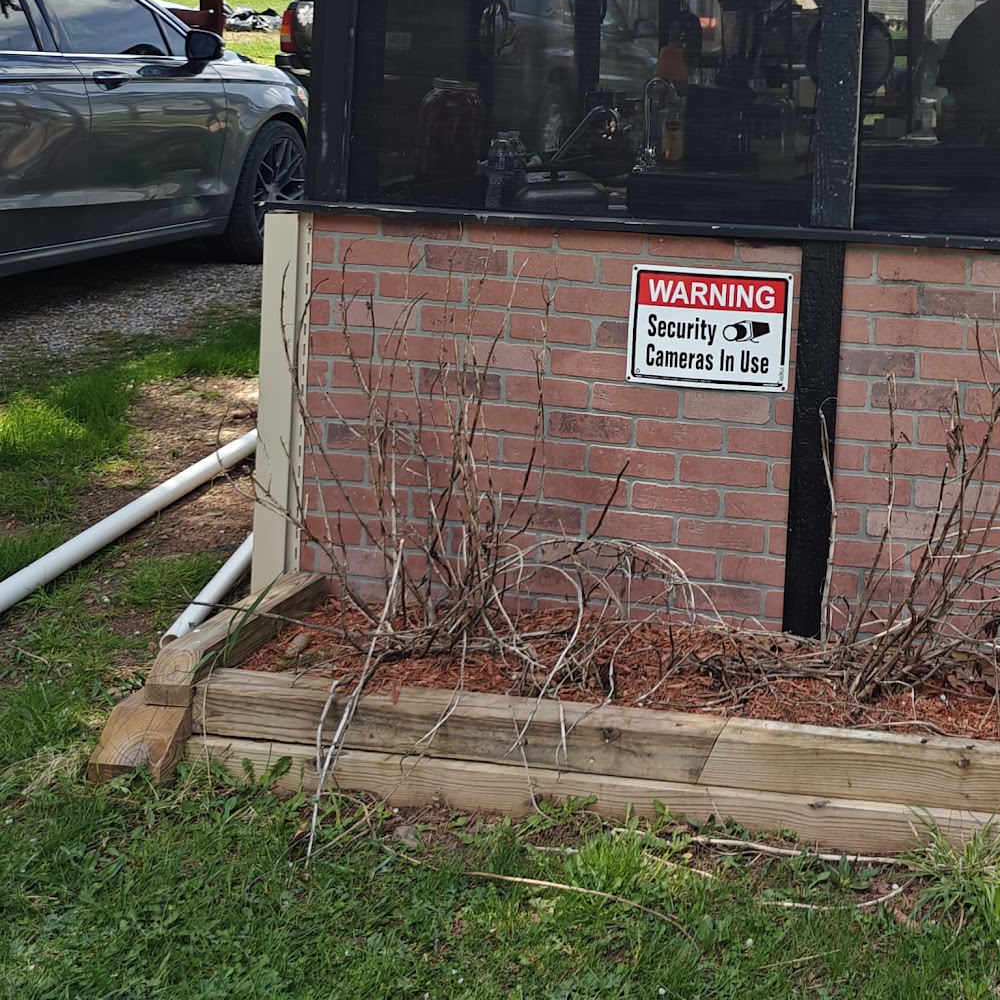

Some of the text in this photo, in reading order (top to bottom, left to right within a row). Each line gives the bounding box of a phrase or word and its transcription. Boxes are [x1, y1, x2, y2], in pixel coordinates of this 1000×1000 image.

[648, 278, 776, 310] WARNING
[647, 313, 717, 346] Security
[645, 343, 769, 374] Cameras In Use
